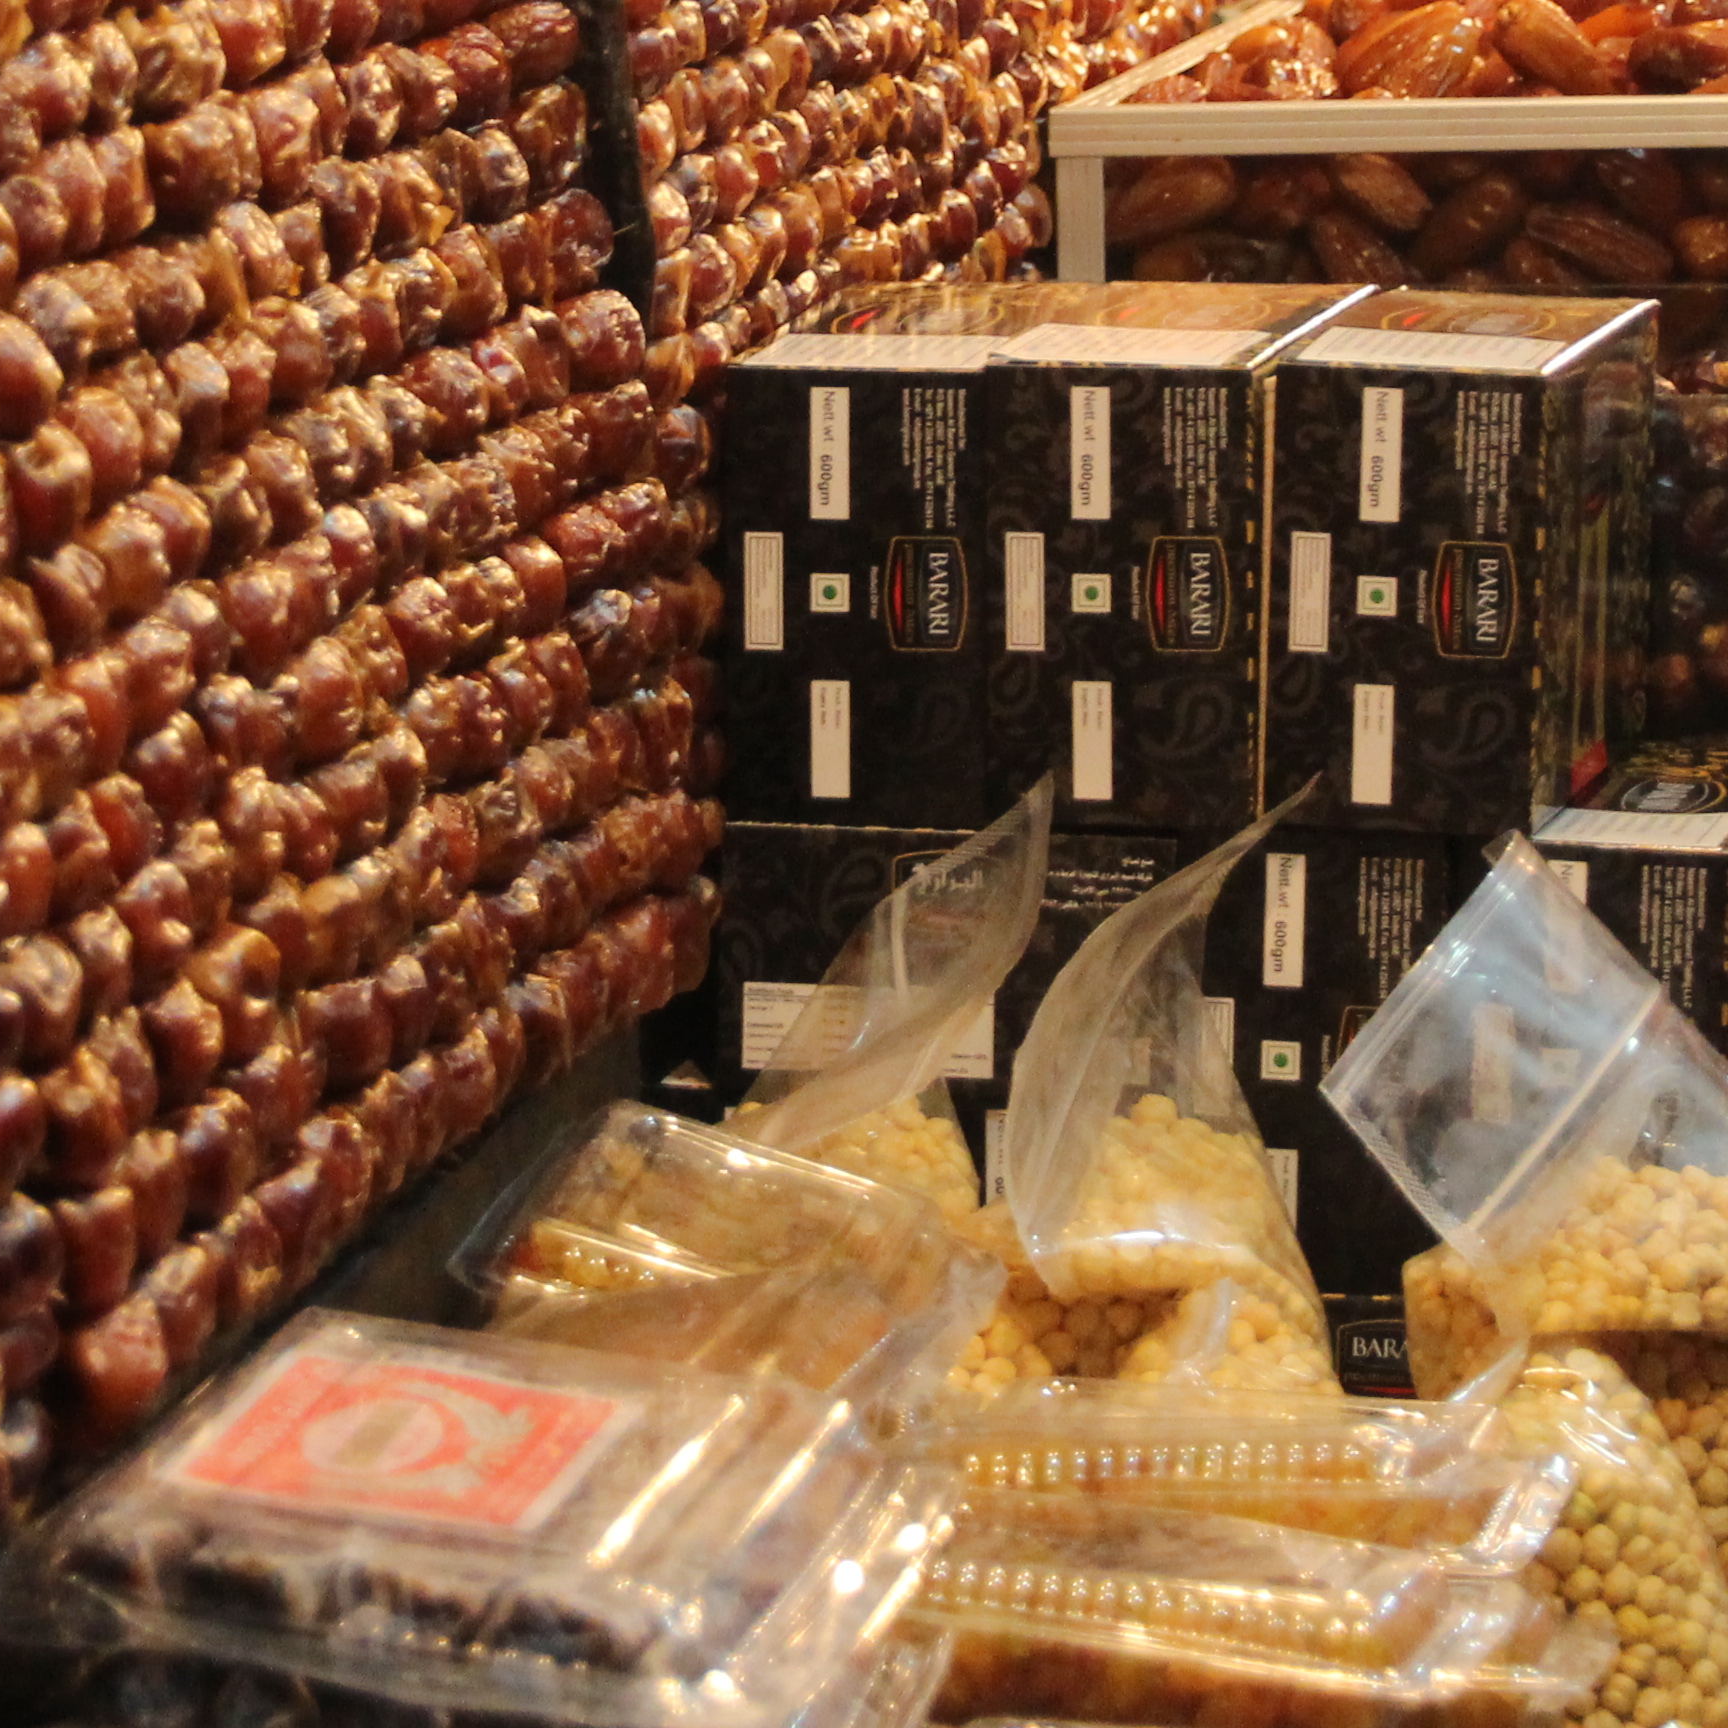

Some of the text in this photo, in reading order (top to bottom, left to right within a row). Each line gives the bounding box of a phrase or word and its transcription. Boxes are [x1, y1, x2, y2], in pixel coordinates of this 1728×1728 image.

[818, 454, 833, 506] 600gm
[1079, 454, 1093, 505] 600gm
[1368, 456, 1384, 507] 600gm
[928, 553, 949, 634] BARARI
[1190, 553, 1211, 635] BARARI
[1476, 558, 1500, 642] BARARI
[1271, 921, 1286, 972] 600gm
